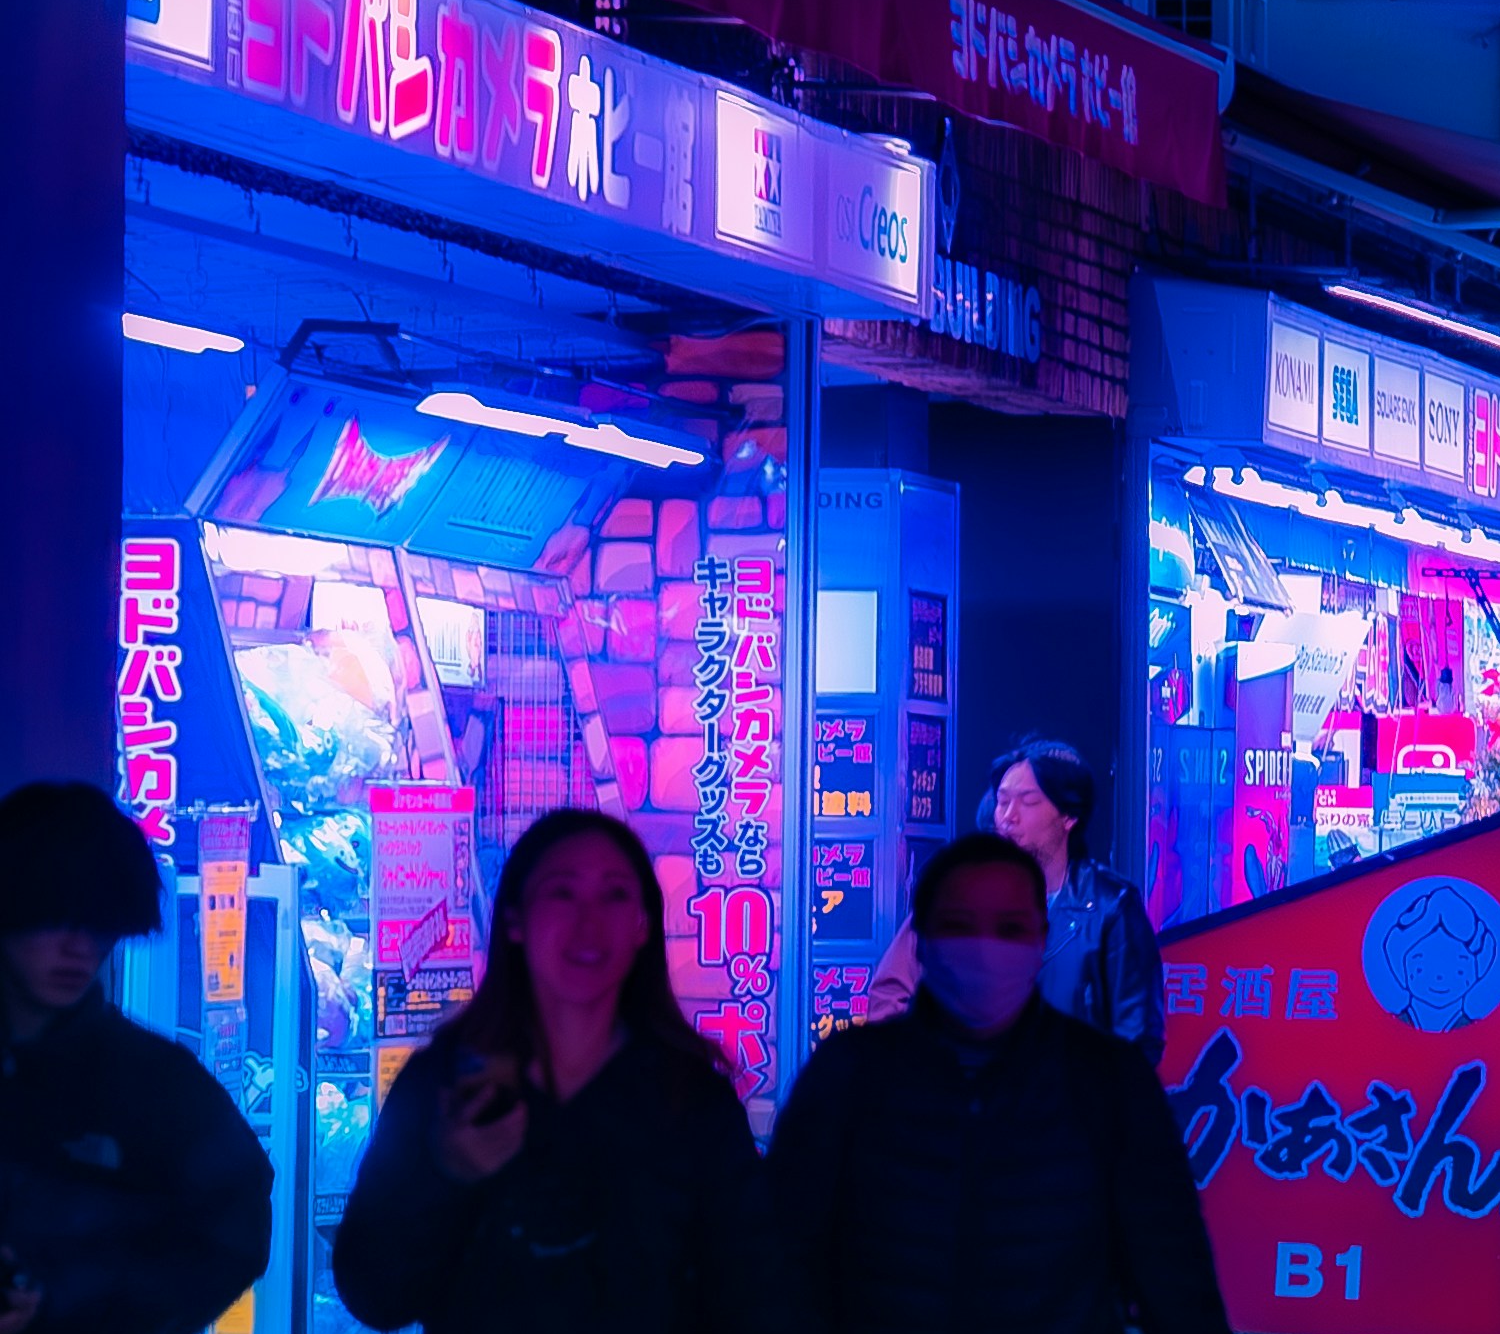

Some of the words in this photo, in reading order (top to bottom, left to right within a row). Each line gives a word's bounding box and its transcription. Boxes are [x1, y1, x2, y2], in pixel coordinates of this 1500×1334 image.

[858, 186, 908, 264] Creos
[1275, 351, 1314, 405] KONAMI
[1333, 365, 1358, 425] SEGA
[1429, 399, 1459, 448] SONY
[694, 555, 730, 877] キャラクターグッズも
[732, 557, 775, 877] ヨドバシカメラなら
[1163, 964, 1339, 1021] 居酒屋
[1274, 1242, 1363, 1300] B1
